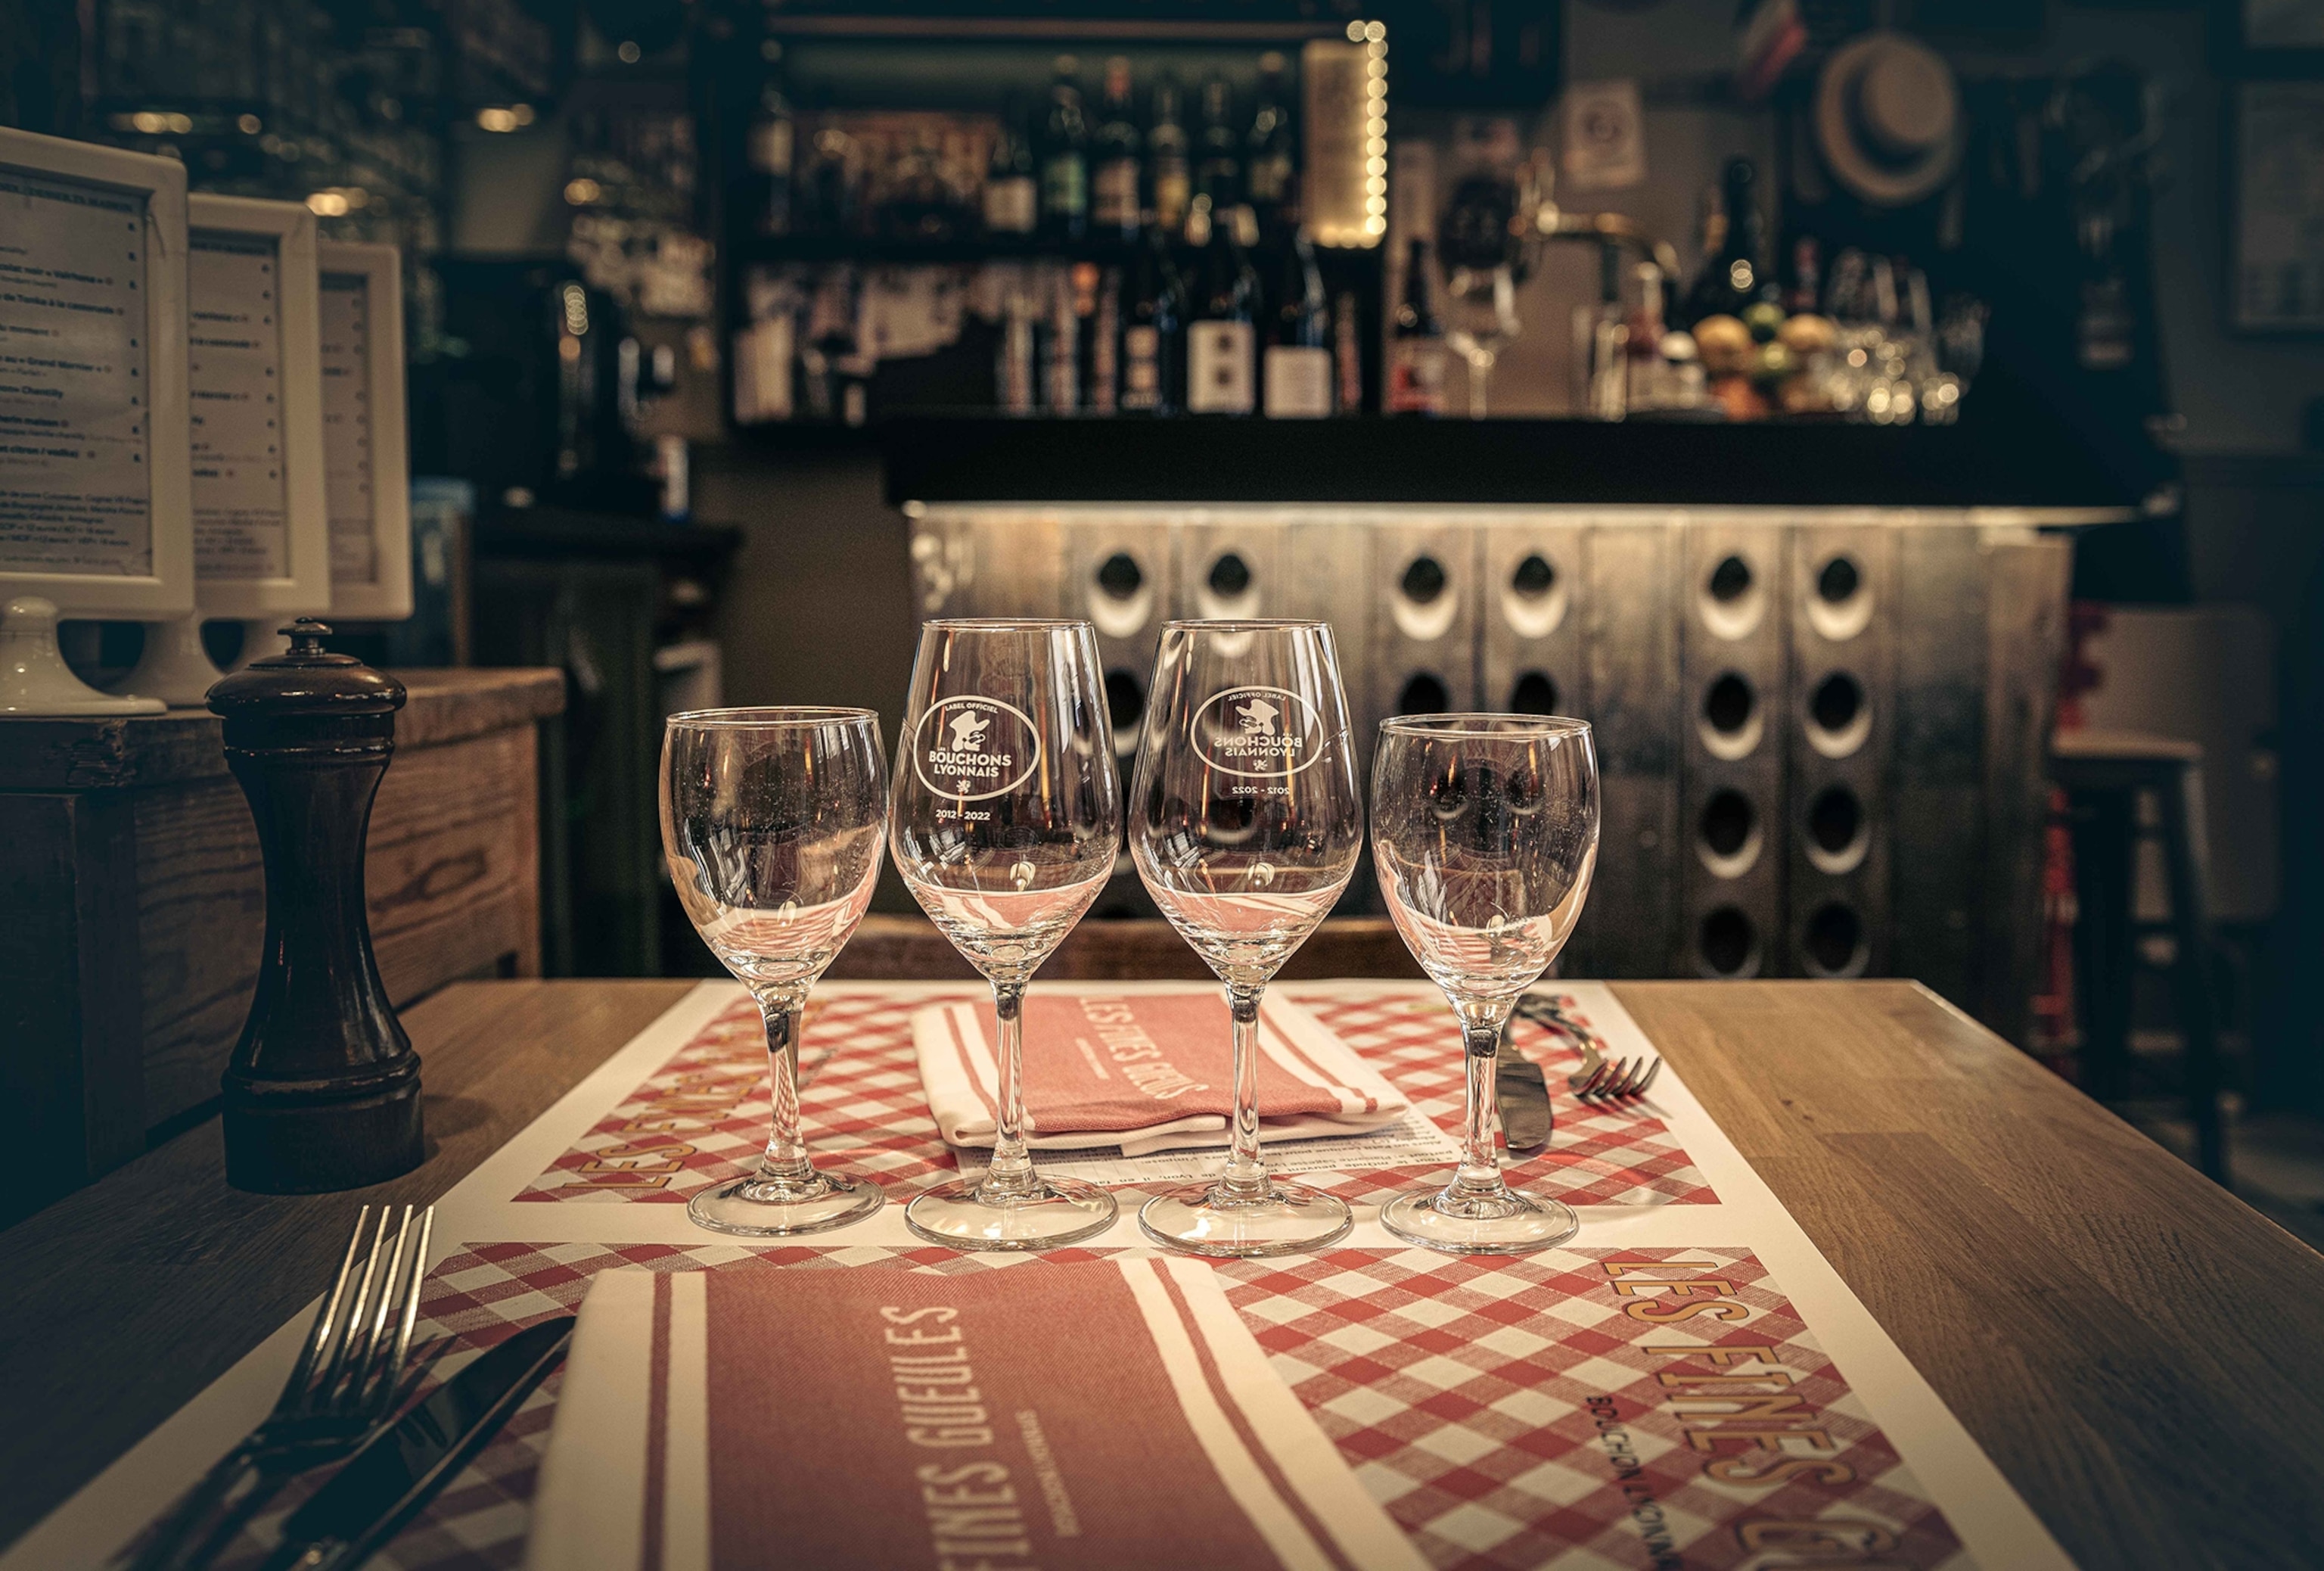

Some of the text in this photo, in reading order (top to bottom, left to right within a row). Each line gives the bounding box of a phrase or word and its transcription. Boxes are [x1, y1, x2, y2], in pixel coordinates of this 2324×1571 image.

[946, 702, 999, 714] LABEL OFFICIEL
[929, 751, 1012, 767] BOUCHONS
[934, 764, 999, 777] LYONNAIS
[935, 809, 956, 819] 2012
[965, 810, 990, 820] 2022
[561, 1143, 698, 1189] LES
[1602, 1261, 1751, 1324] LES
[879, 1306, 993, 1448] GUEULES
[1586, 1396, 1642, 1481] BOUCHON
[1641, 1345, 1858, 1488] FINES
